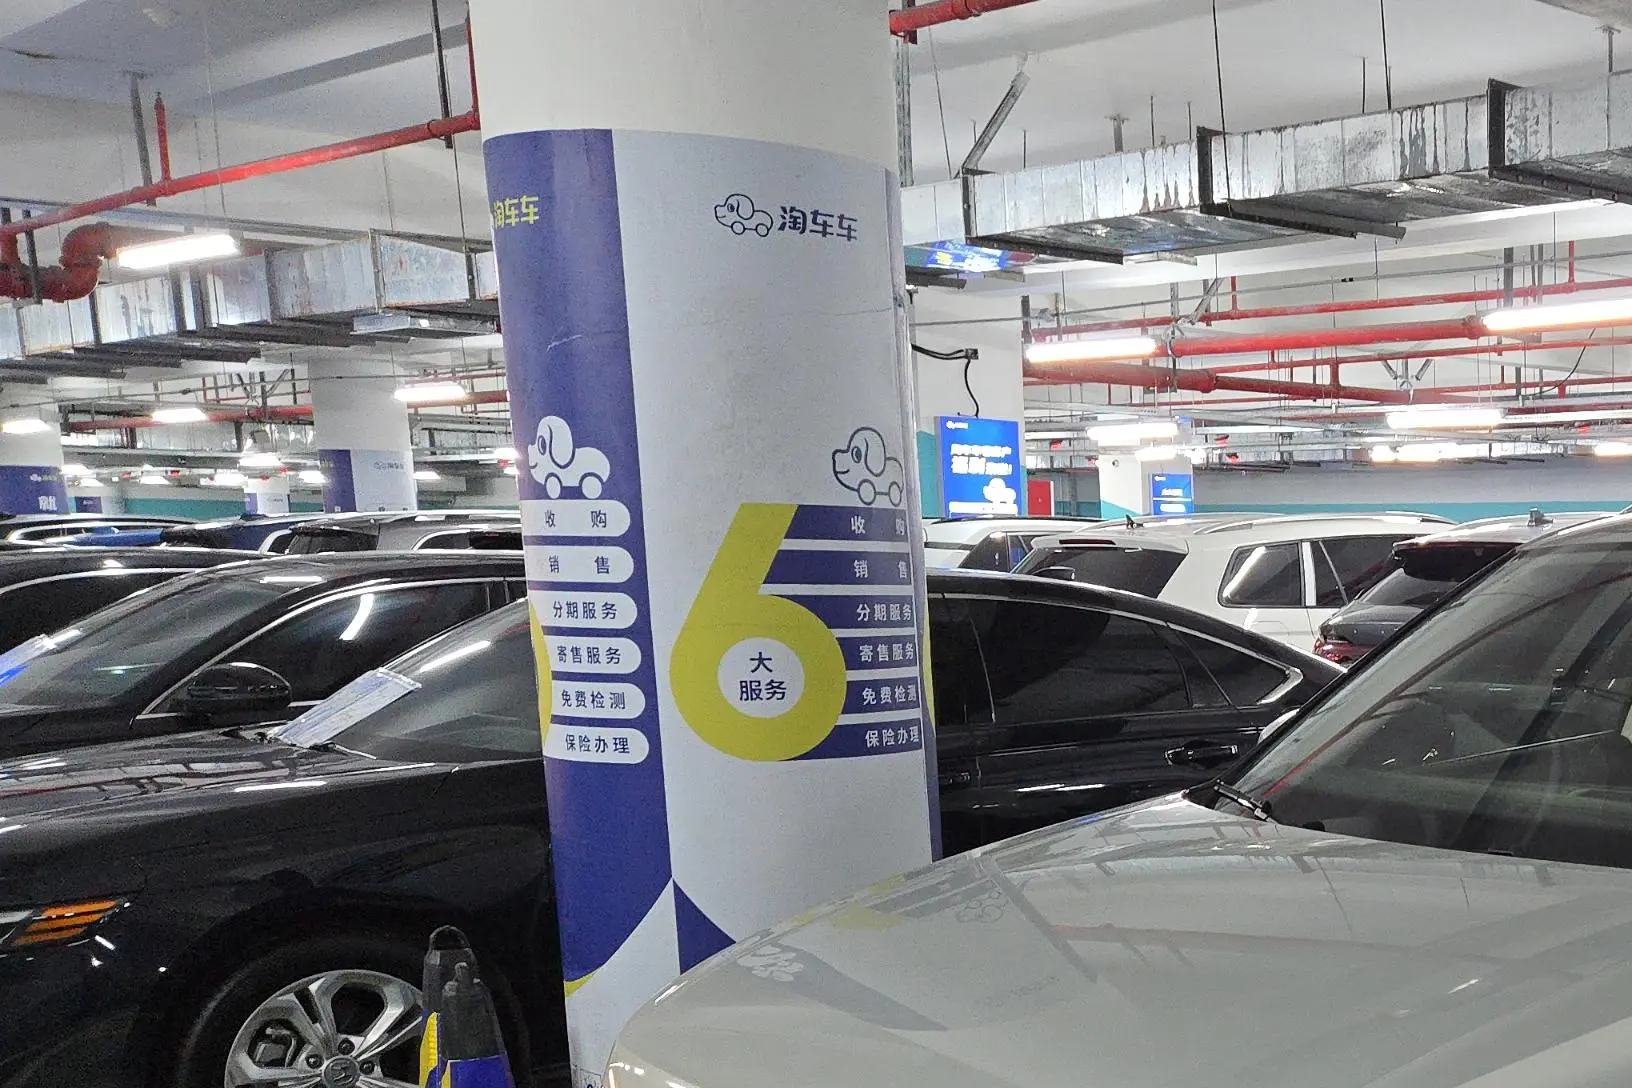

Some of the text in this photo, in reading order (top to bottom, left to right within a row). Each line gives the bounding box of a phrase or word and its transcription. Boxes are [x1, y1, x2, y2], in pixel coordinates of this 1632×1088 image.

[777, 206, 858, 242] 淘车车
[545, 510, 607, 529] 收购
[549, 556, 610, 575] 销售
[854, 560, 908, 579] 销售
[553, 601, 618, 620] 分期服务
[857, 603, 912, 622] 分期服务
[557, 645, 621, 665] 寄售服务
[859, 642, 914, 663] 寄售服务
[750, 652, 773, 674] 大
[561, 690, 626, 710] 免费检测
[739, 679, 787, 702] 服务
[862, 684, 917, 706] 免费检测
[565, 734, 630, 754] 保险办理
[865, 725, 920, 748] 保险办理
